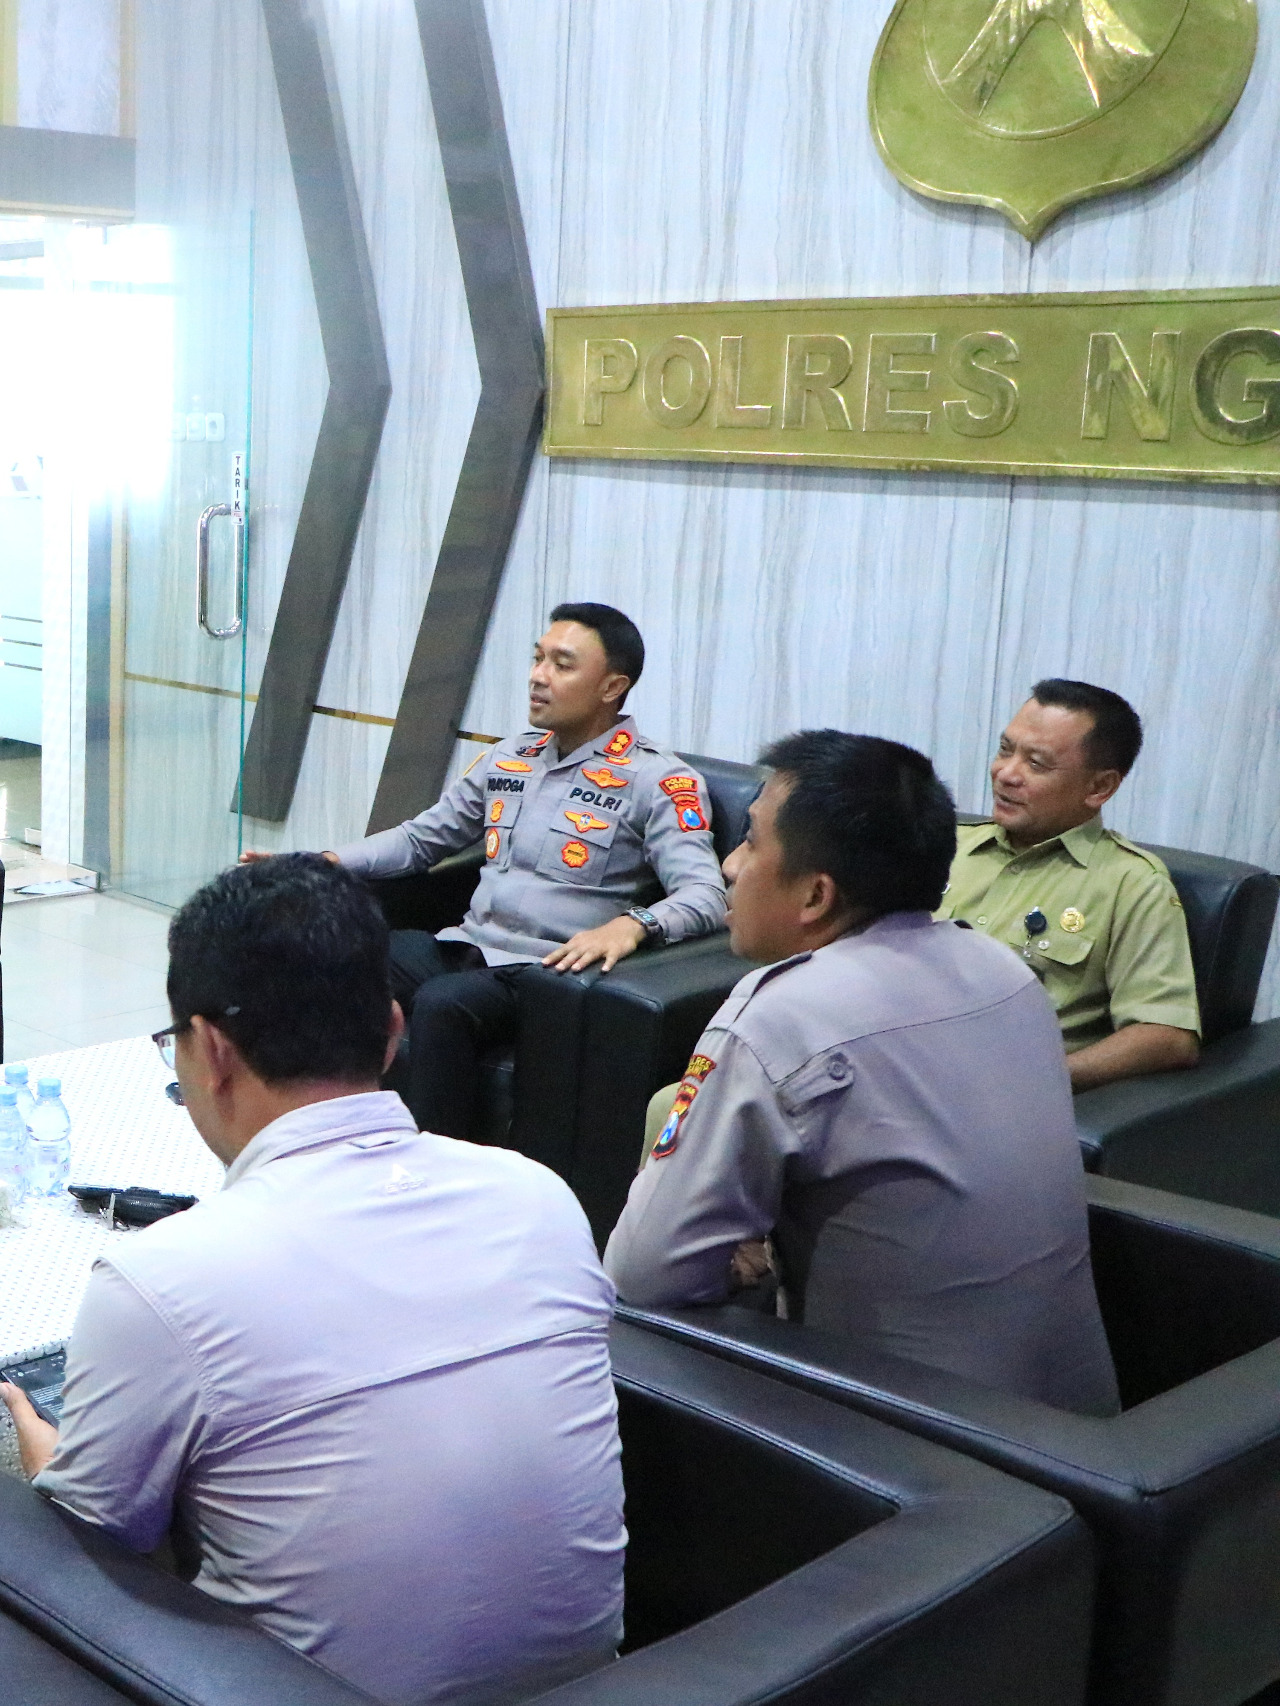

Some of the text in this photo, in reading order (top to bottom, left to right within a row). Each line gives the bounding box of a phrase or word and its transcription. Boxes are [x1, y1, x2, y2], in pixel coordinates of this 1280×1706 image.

[582, 327, 1280, 446] POLRES NG
[487, 777, 525, 793] AYOGA
[569, 786, 623, 812] POLRI
